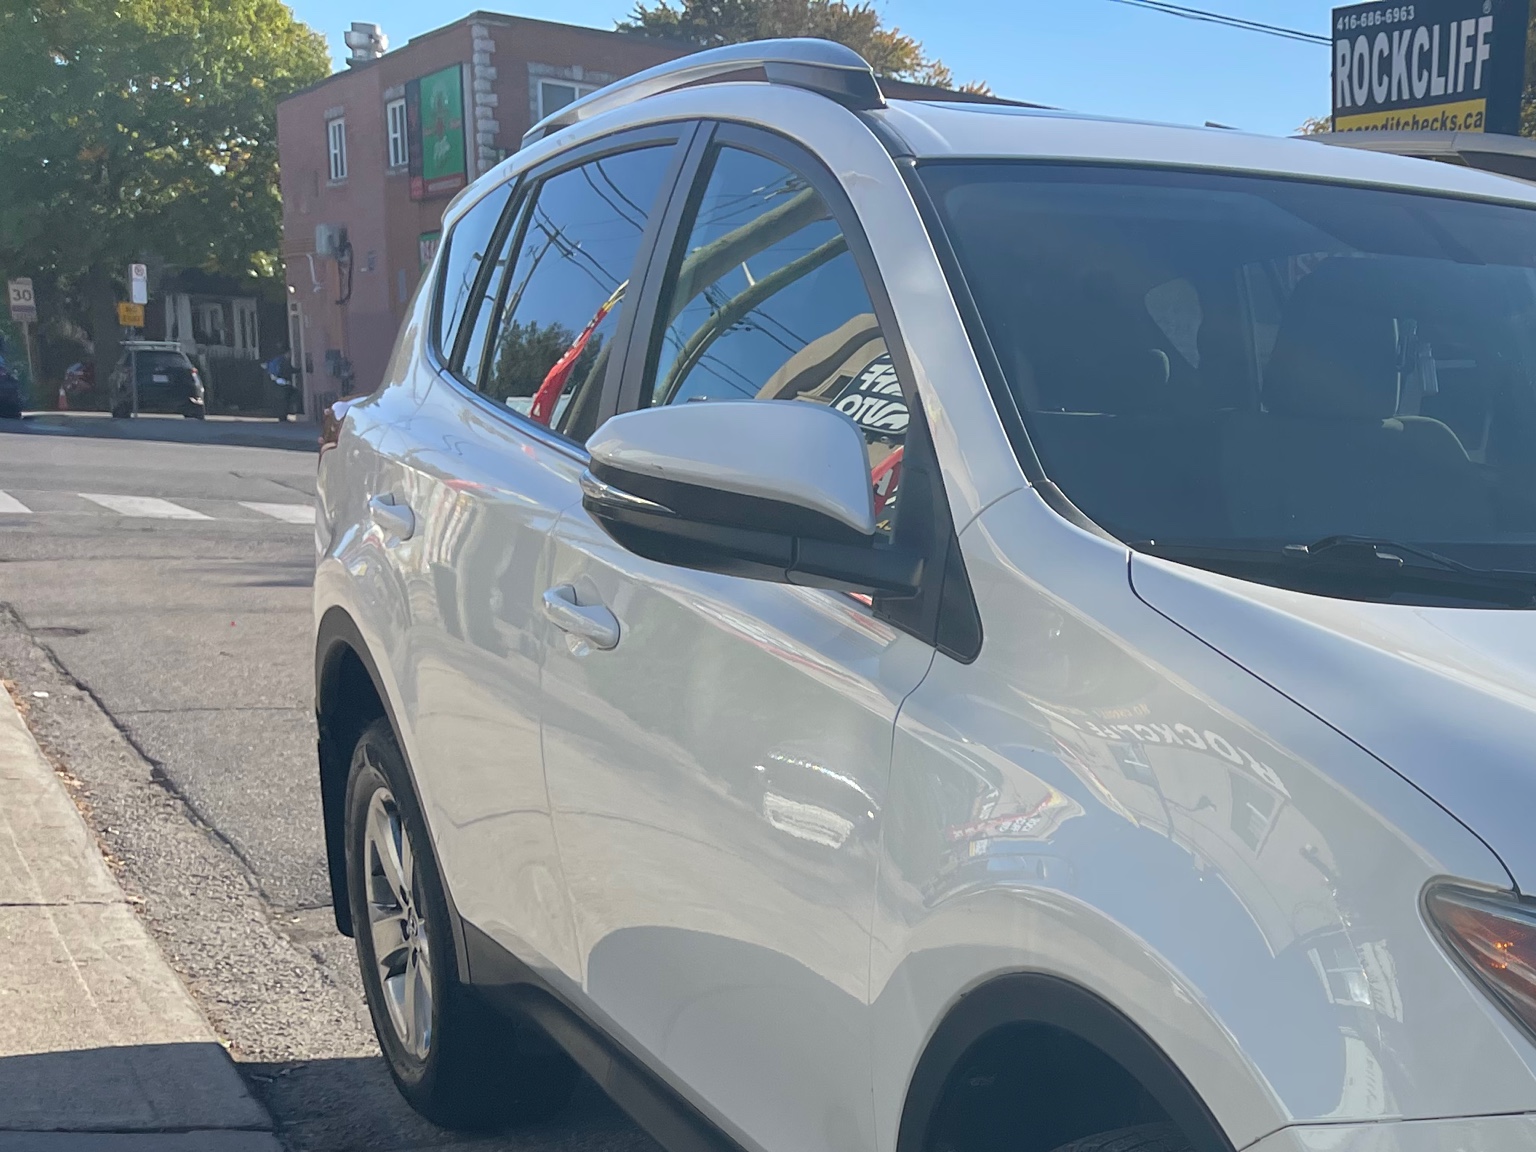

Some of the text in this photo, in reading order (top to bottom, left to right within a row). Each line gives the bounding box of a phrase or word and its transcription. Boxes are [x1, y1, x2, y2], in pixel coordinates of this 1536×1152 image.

[1337, 6, 1415, 31] 416-686-6963
[1336, 15, 1493, 108] ROCKCLIFF
[1337, 110, 1483, 132] ditchecks.ca
[12, 289, 32, 301] 30
